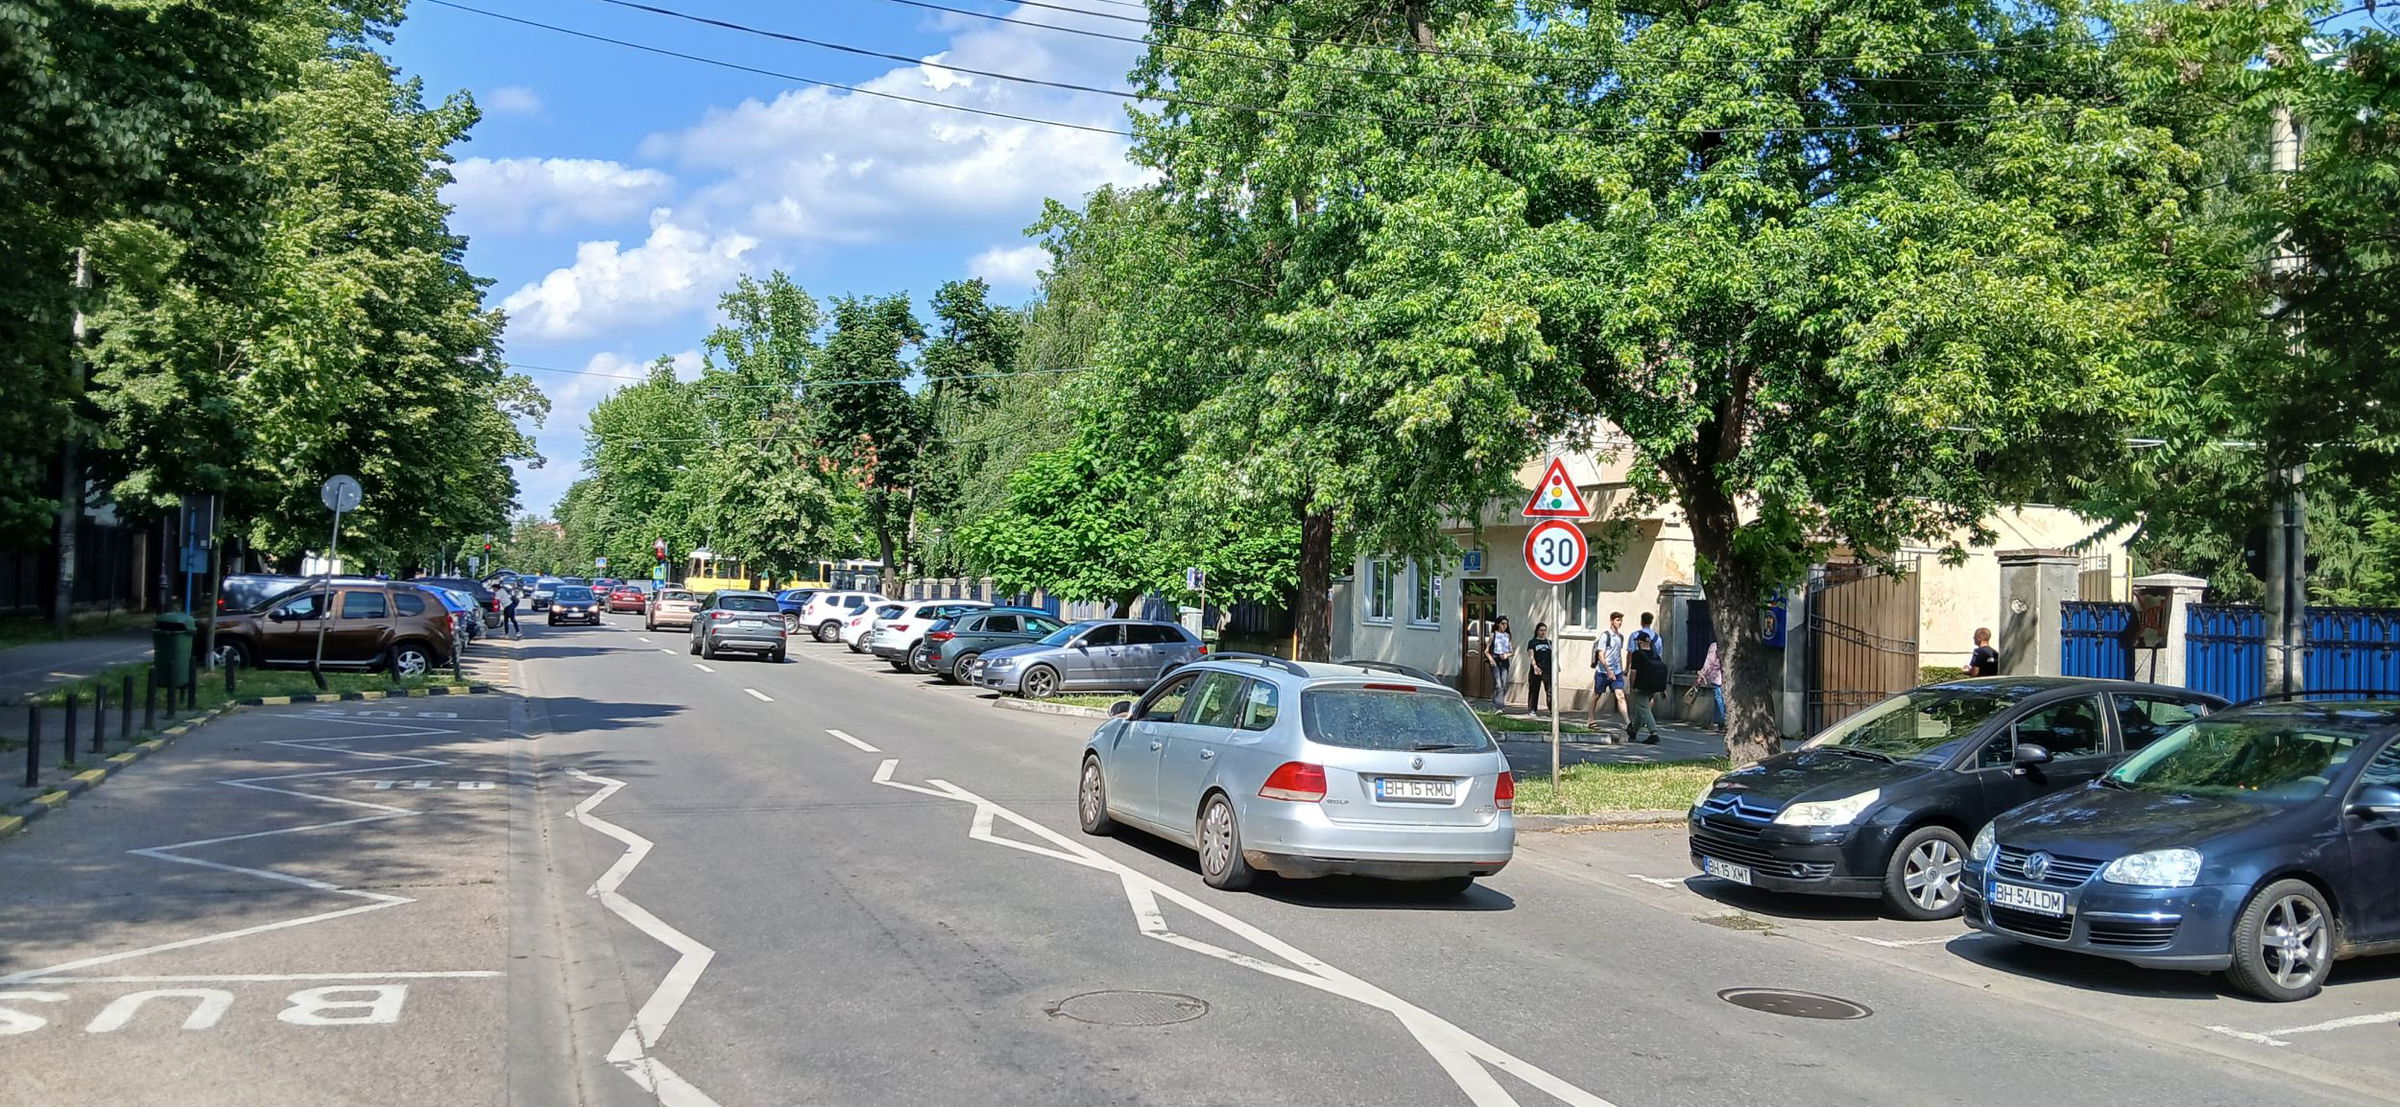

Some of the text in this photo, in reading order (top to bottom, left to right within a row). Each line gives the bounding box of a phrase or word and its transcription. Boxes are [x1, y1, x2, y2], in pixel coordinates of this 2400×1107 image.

[1540, 537, 1573, 567] 30
[1385, 783, 1454, 797] BH 15 RMU
[1709, 859, 1720, 874] BH
[1996, 885, 2013, 903] BH
[2016, 887, 2031, 906] 54
[2033, 892, 2061, 912] LDM
